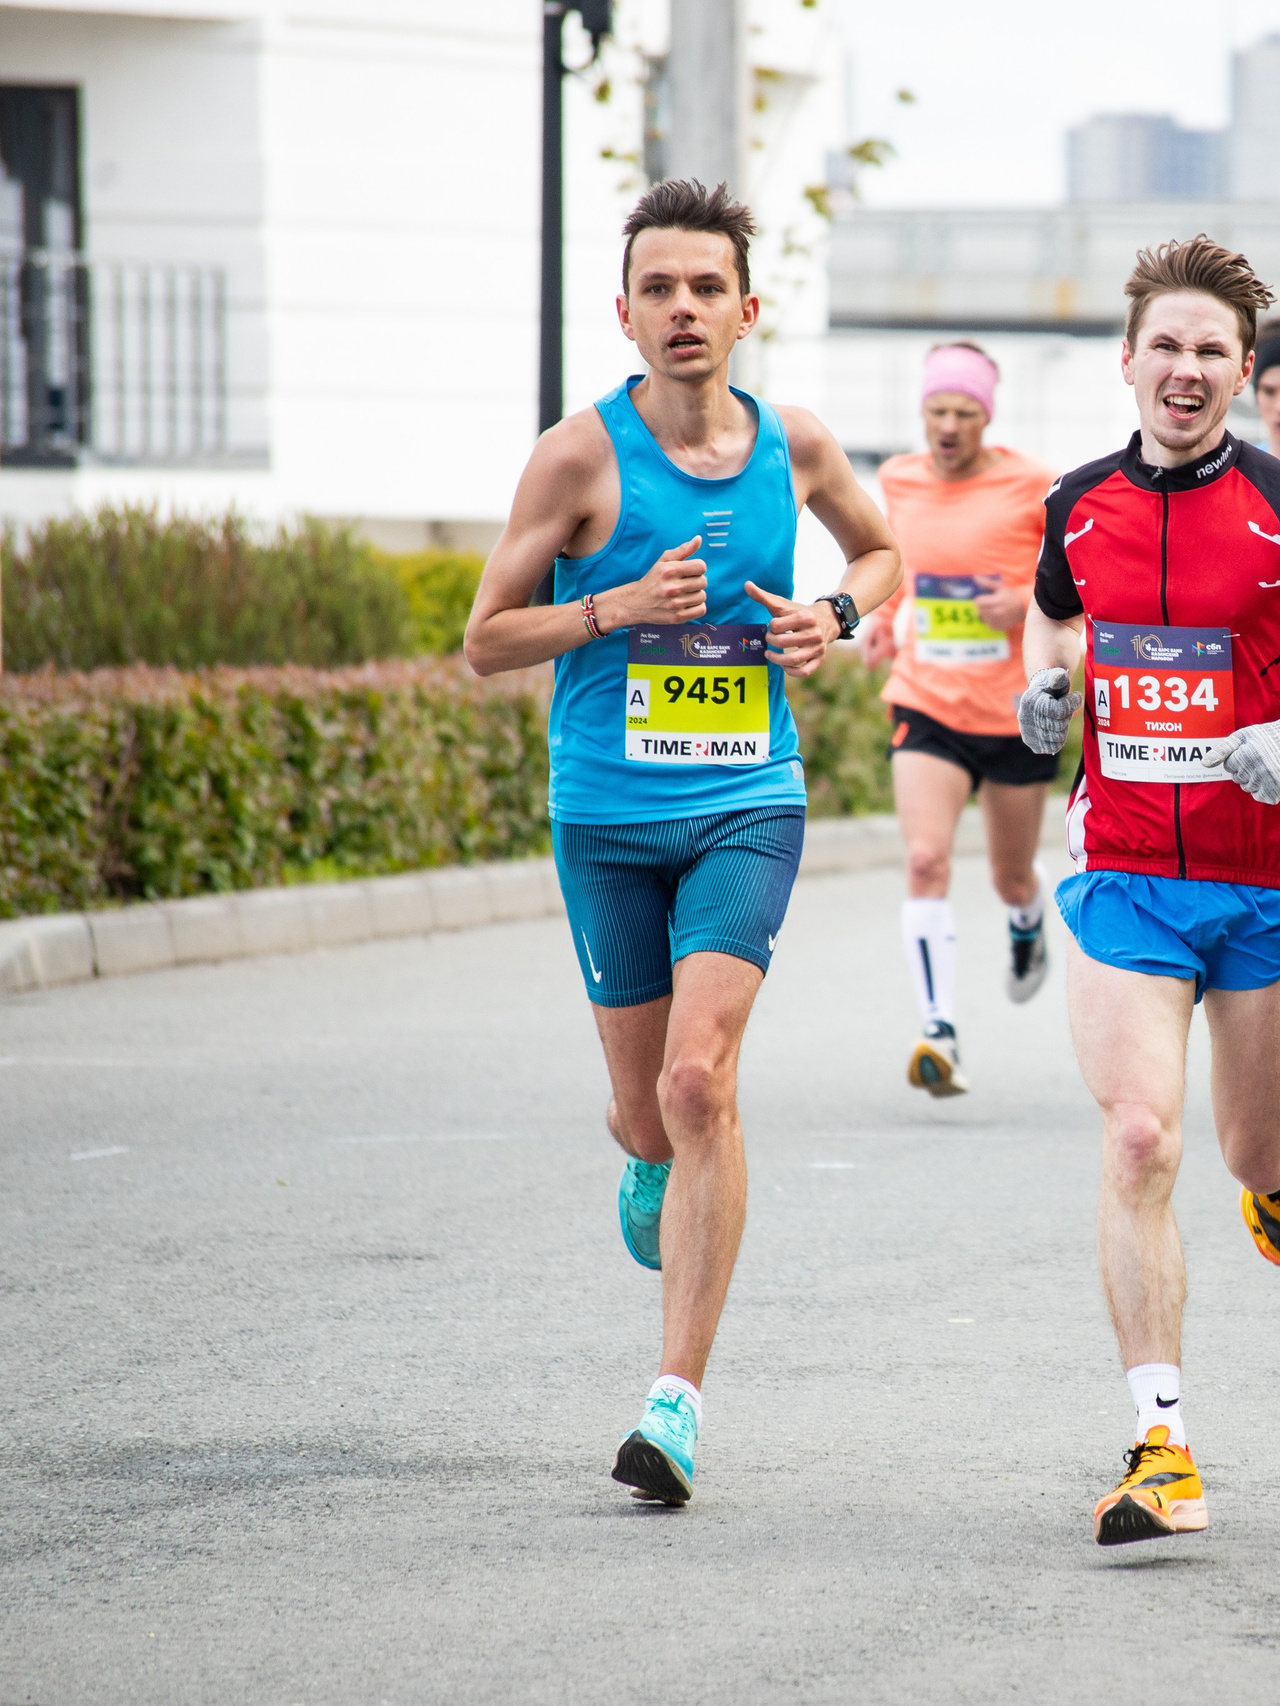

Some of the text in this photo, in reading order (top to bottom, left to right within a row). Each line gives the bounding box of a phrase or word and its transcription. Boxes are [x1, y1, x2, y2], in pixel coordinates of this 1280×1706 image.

[934, 606, 981, 625] 545
[629, 675, 746, 707] A 9451
[1098, 674, 1219, 712] A 1334
[629, 716, 648, 725] 2024
[1098, 718, 1110, 727] 2024
[1145, 721, 1183, 732] ТИХОН
